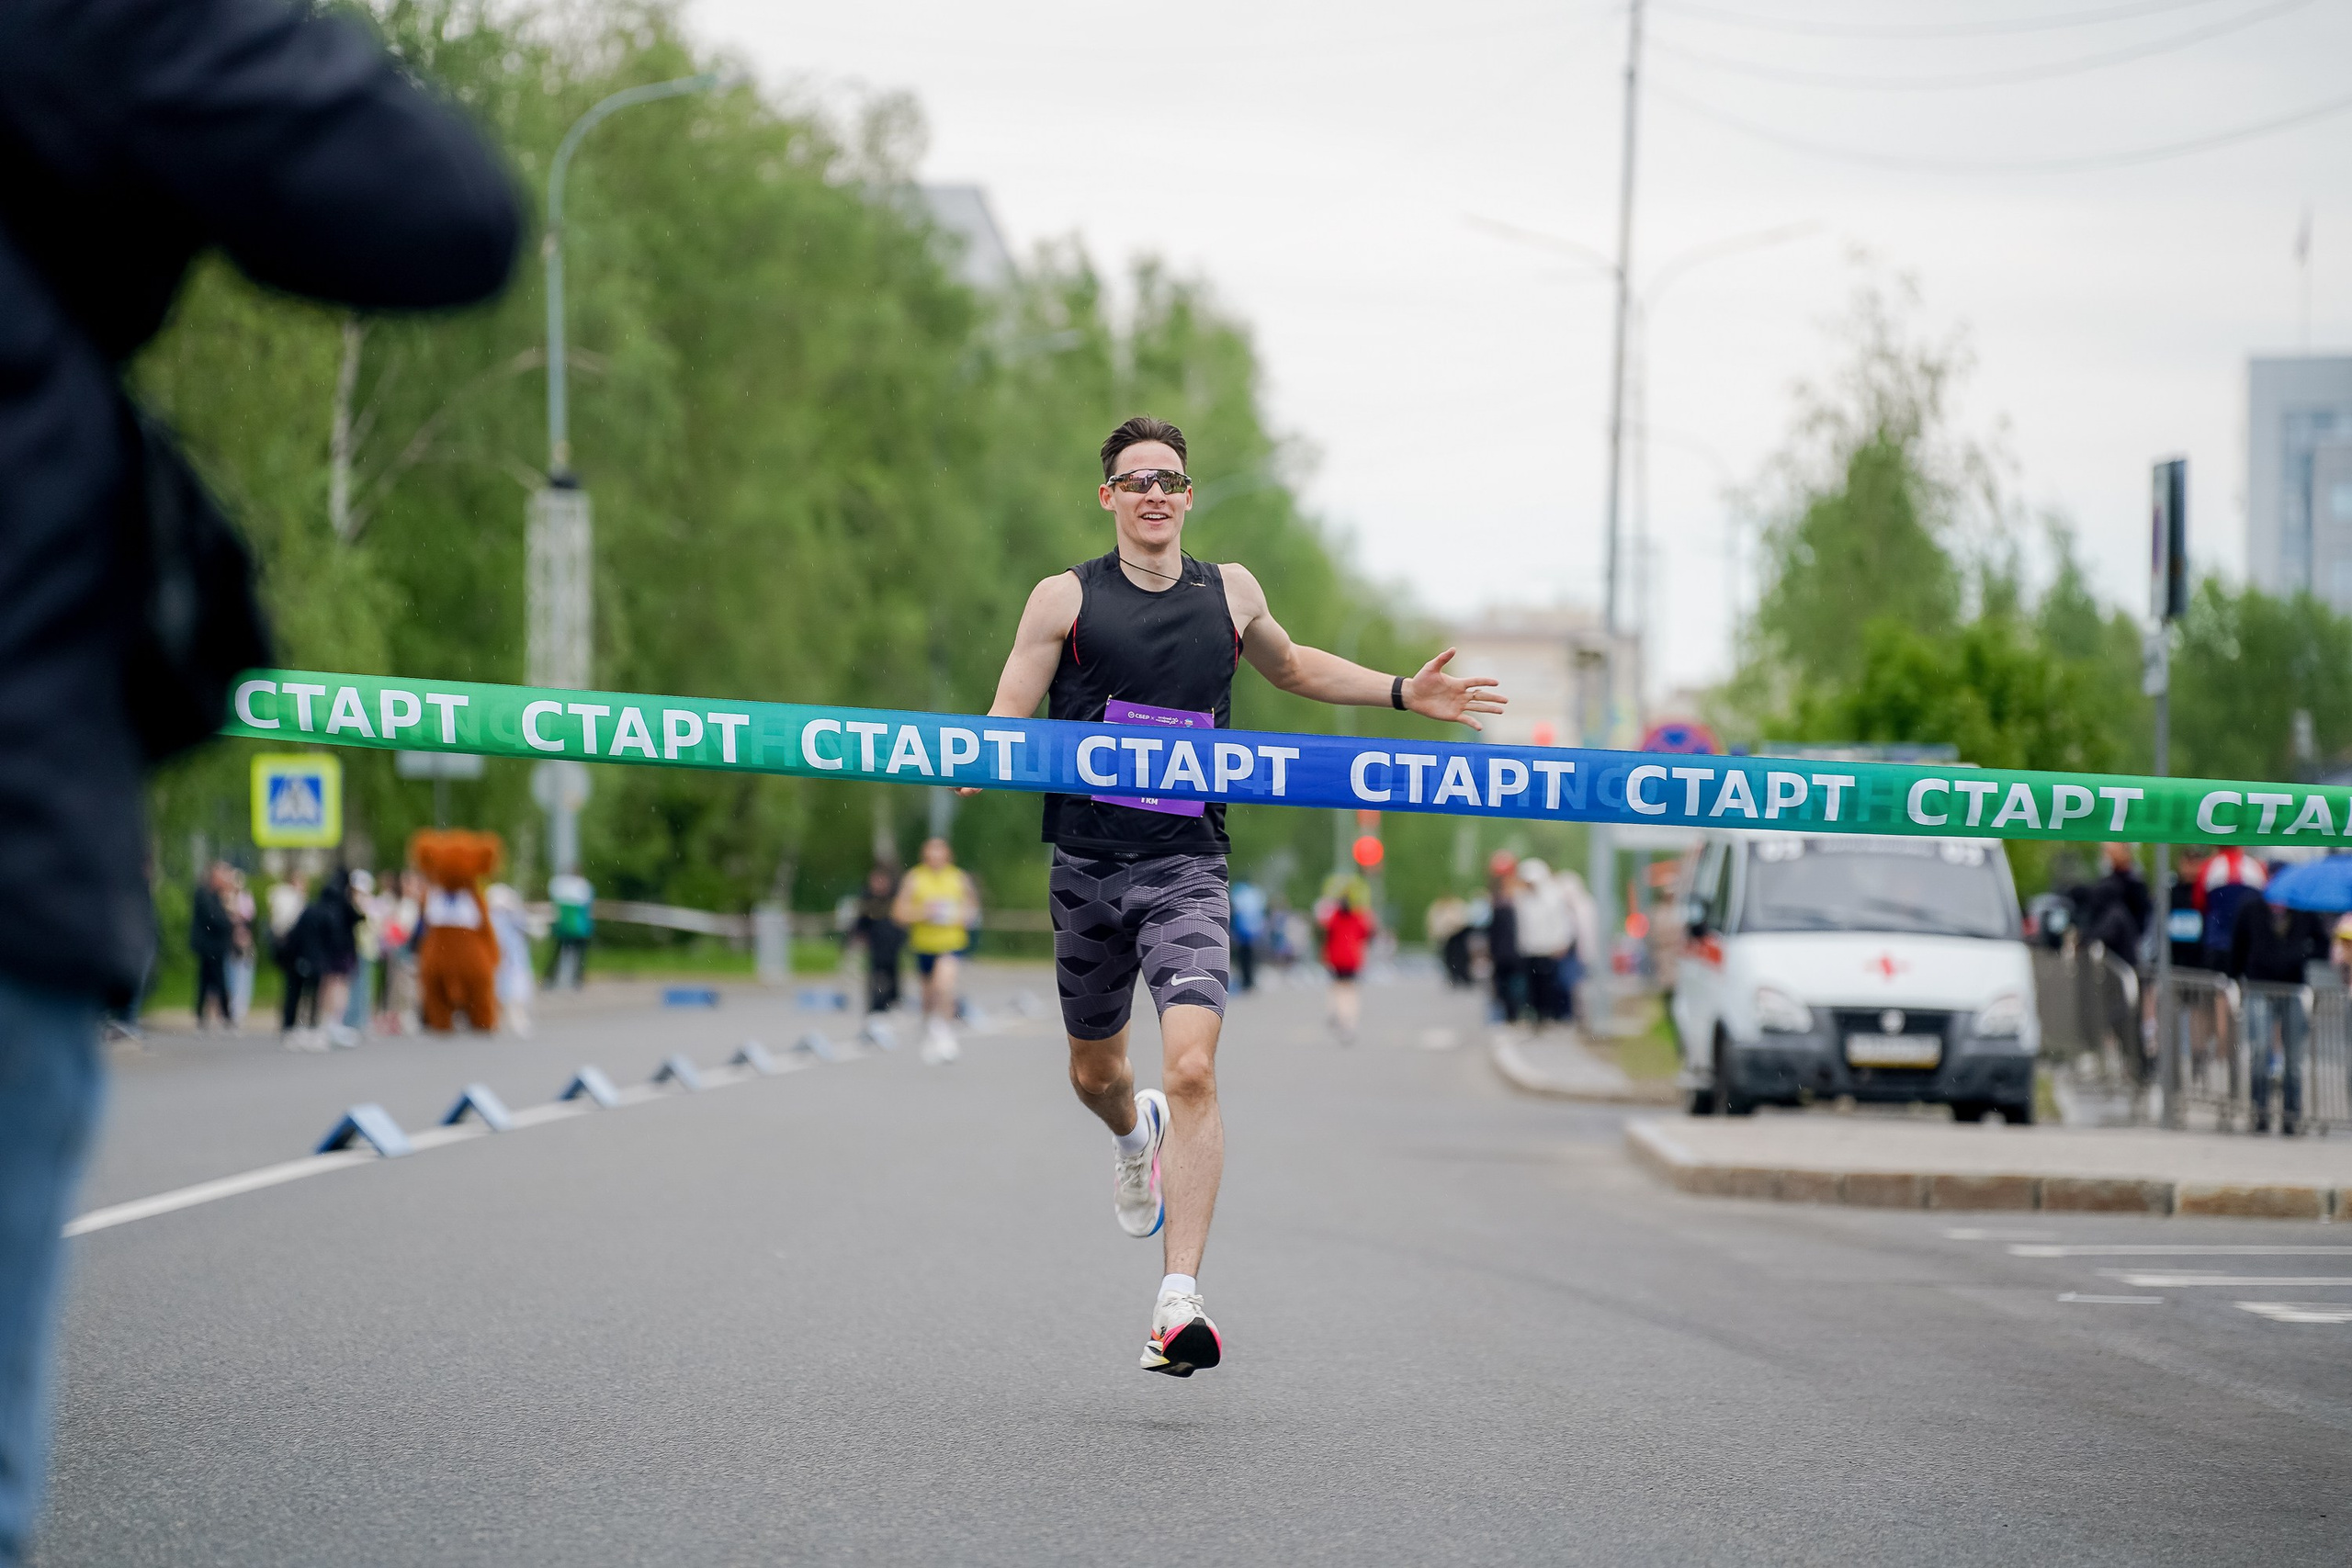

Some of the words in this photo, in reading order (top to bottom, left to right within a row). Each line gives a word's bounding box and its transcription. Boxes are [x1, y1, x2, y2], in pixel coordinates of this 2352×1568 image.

[234, 680, 469, 744] СТАРТ
[521, 700, 750, 763] СТАРТ
[801, 718, 1026, 781] СТАРТ
[1076, 735, 1300, 796] СТАРТ
[1350, 750, 1575, 809] СТАРТ
[1626, 764, 1855, 821] СТАРТ
[1908, 778, 2144, 831] СТАРТ
[2196, 790, 2352, 837] СТА
